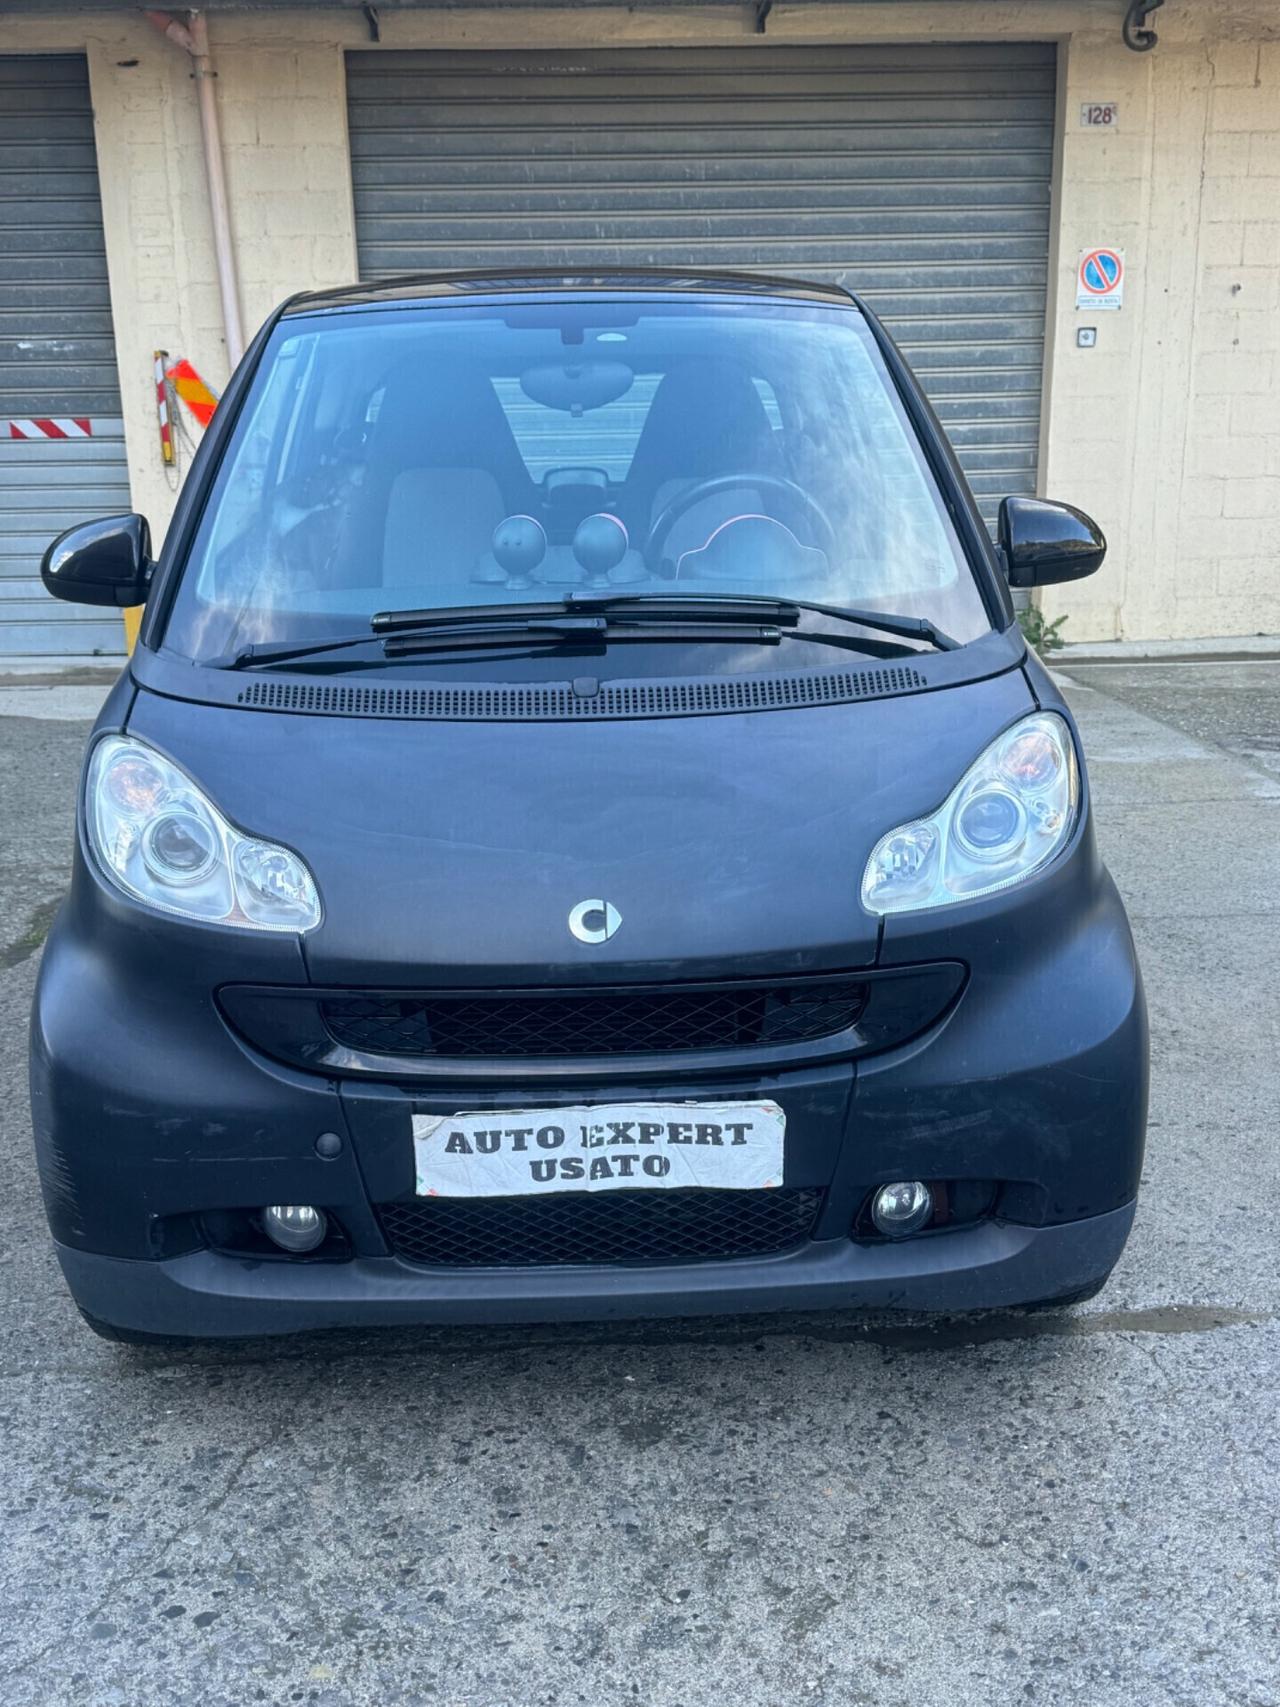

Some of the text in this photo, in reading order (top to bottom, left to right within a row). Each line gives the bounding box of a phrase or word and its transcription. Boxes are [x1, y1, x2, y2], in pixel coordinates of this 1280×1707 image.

[444, 1122, 753, 1154] AUTO EXPERT
[529, 1154, 671, 1183] USATO
